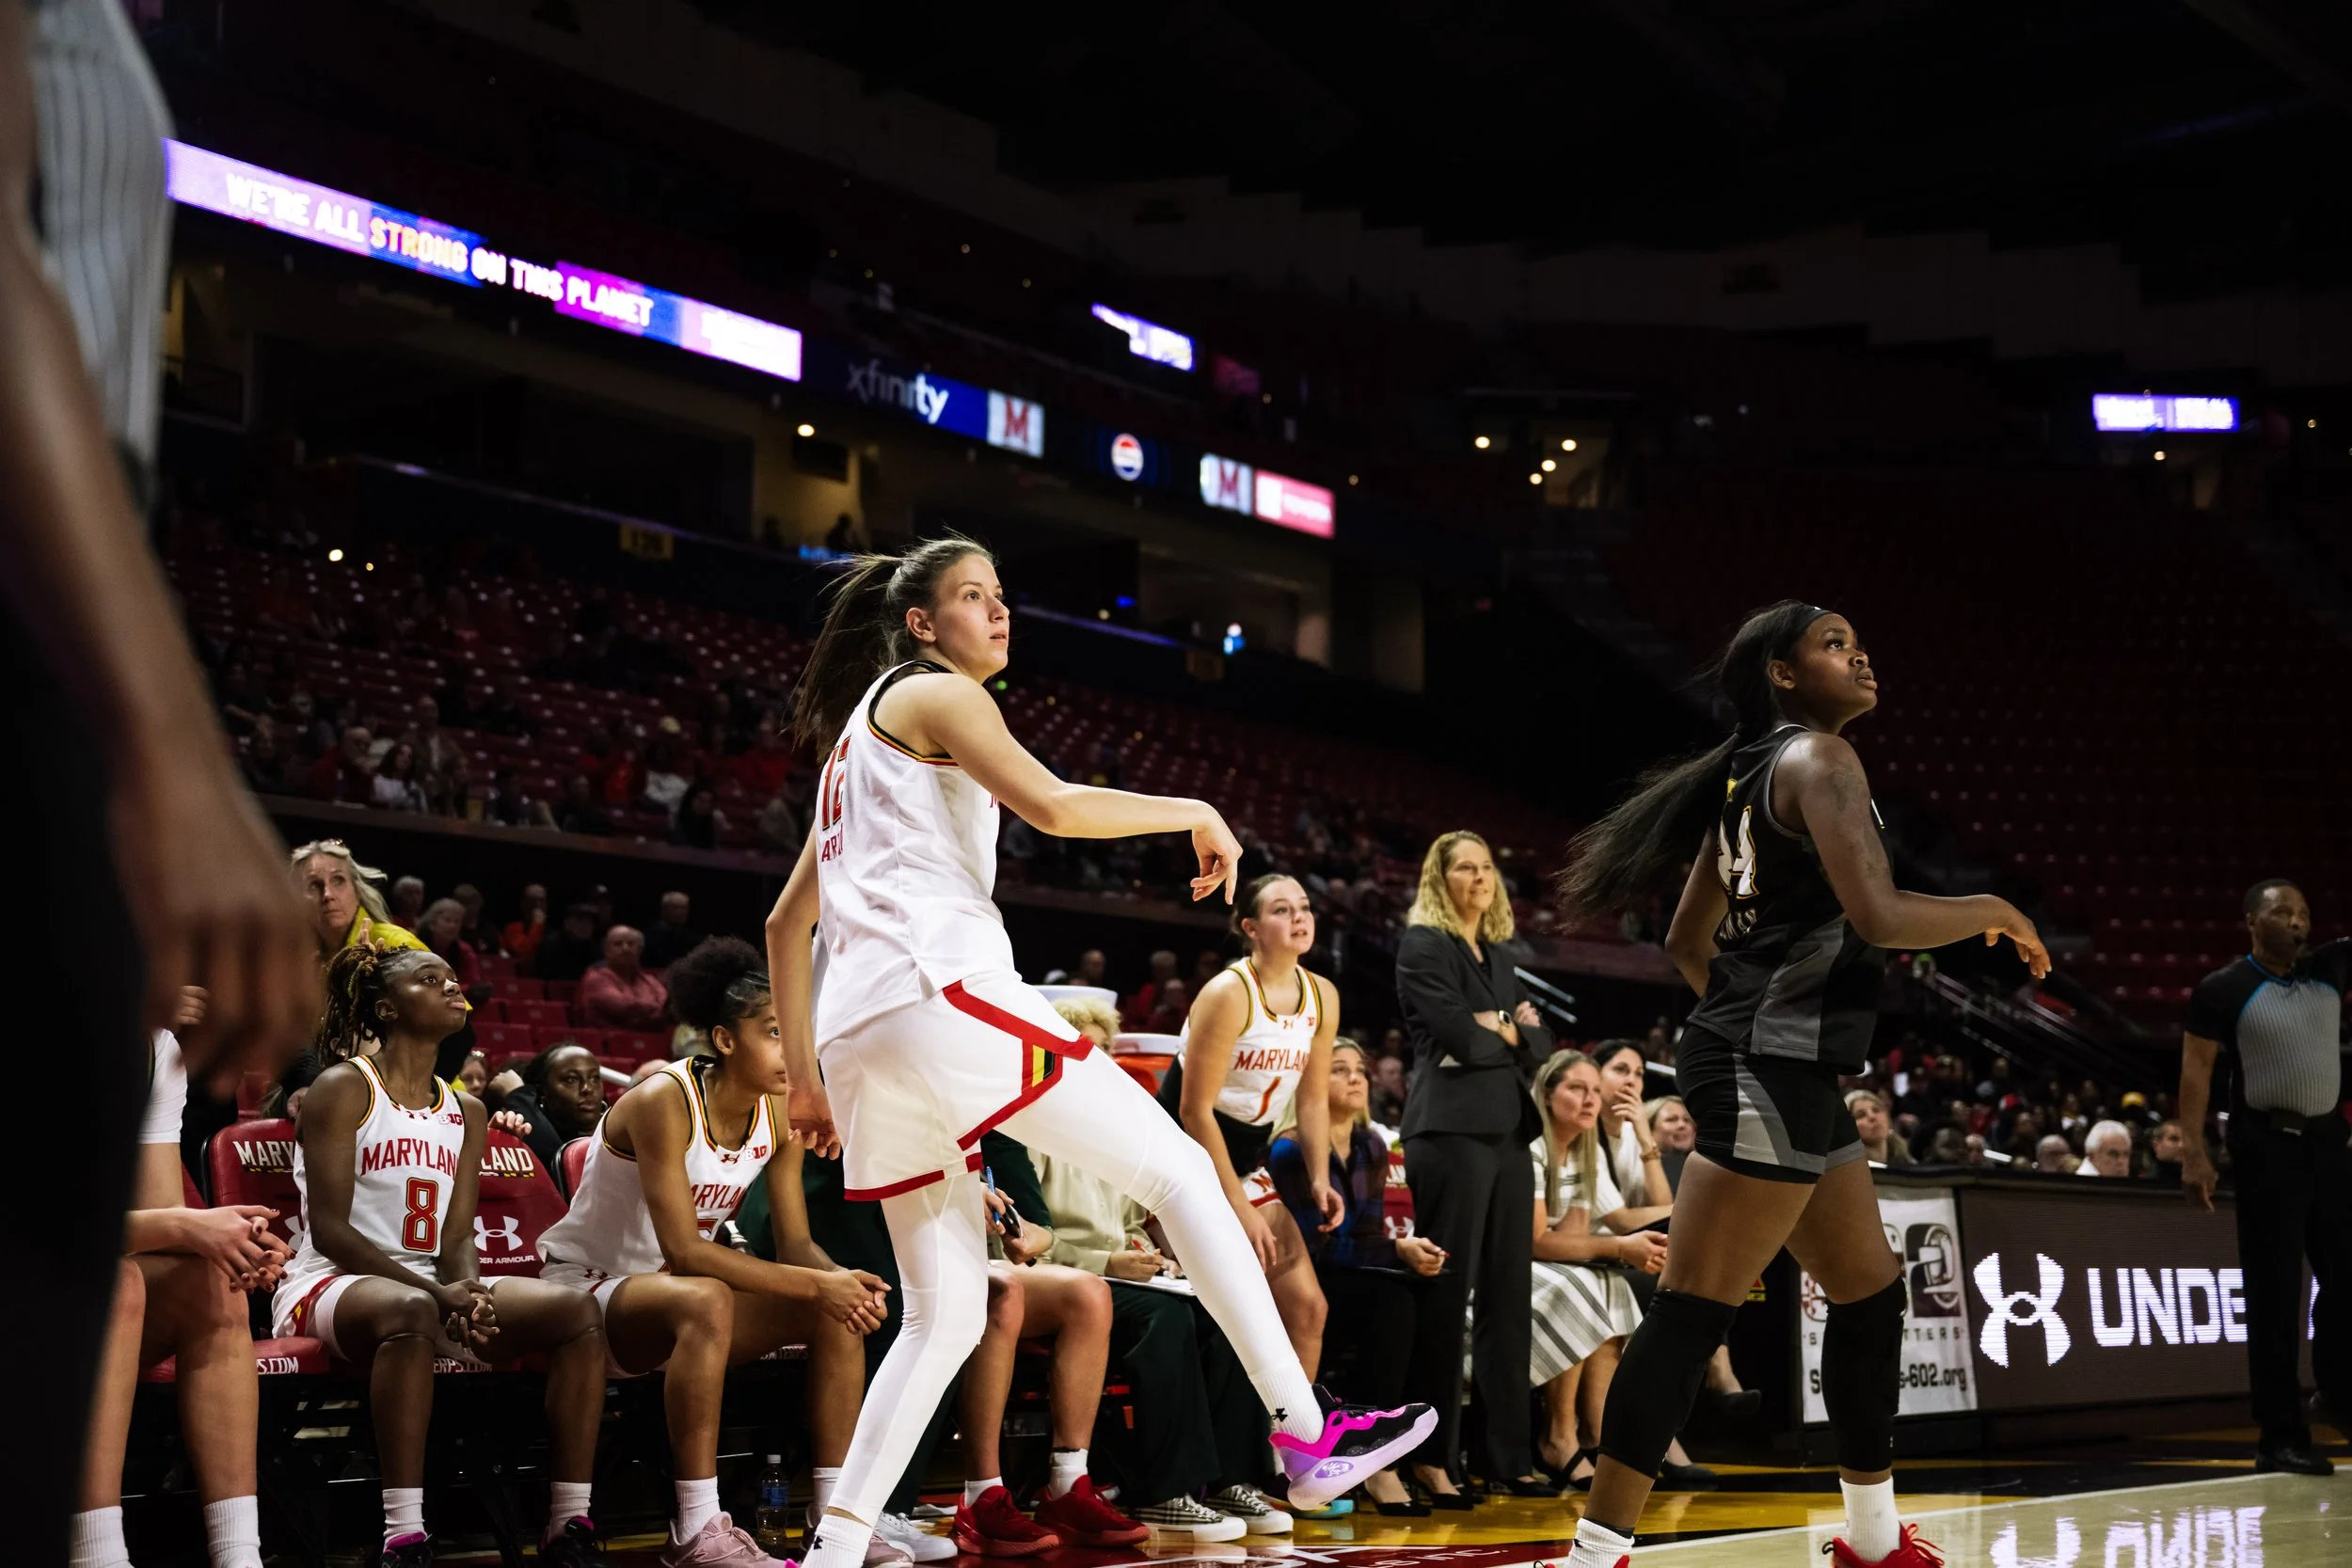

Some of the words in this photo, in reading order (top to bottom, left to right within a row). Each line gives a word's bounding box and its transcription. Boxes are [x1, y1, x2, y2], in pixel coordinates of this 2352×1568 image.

[315, 199, 365, 243] ALL
[370, 216, 469, 274] STRONG
[470, 247, 507, 285] ON
[510, 257, 564, 302] THIS
[566, 275, 655, 328] PLANET
[847, 357, 950, 425] xfinity
[232, 1140, 294, 1166] MARY
[360, 1137, 459, 1181] MARYLAN
[480, 1146, 535, 1172] LAND
[402, 1176, 439, 1253] 8
[2087, 1267, 2250, 1347] UNDE
